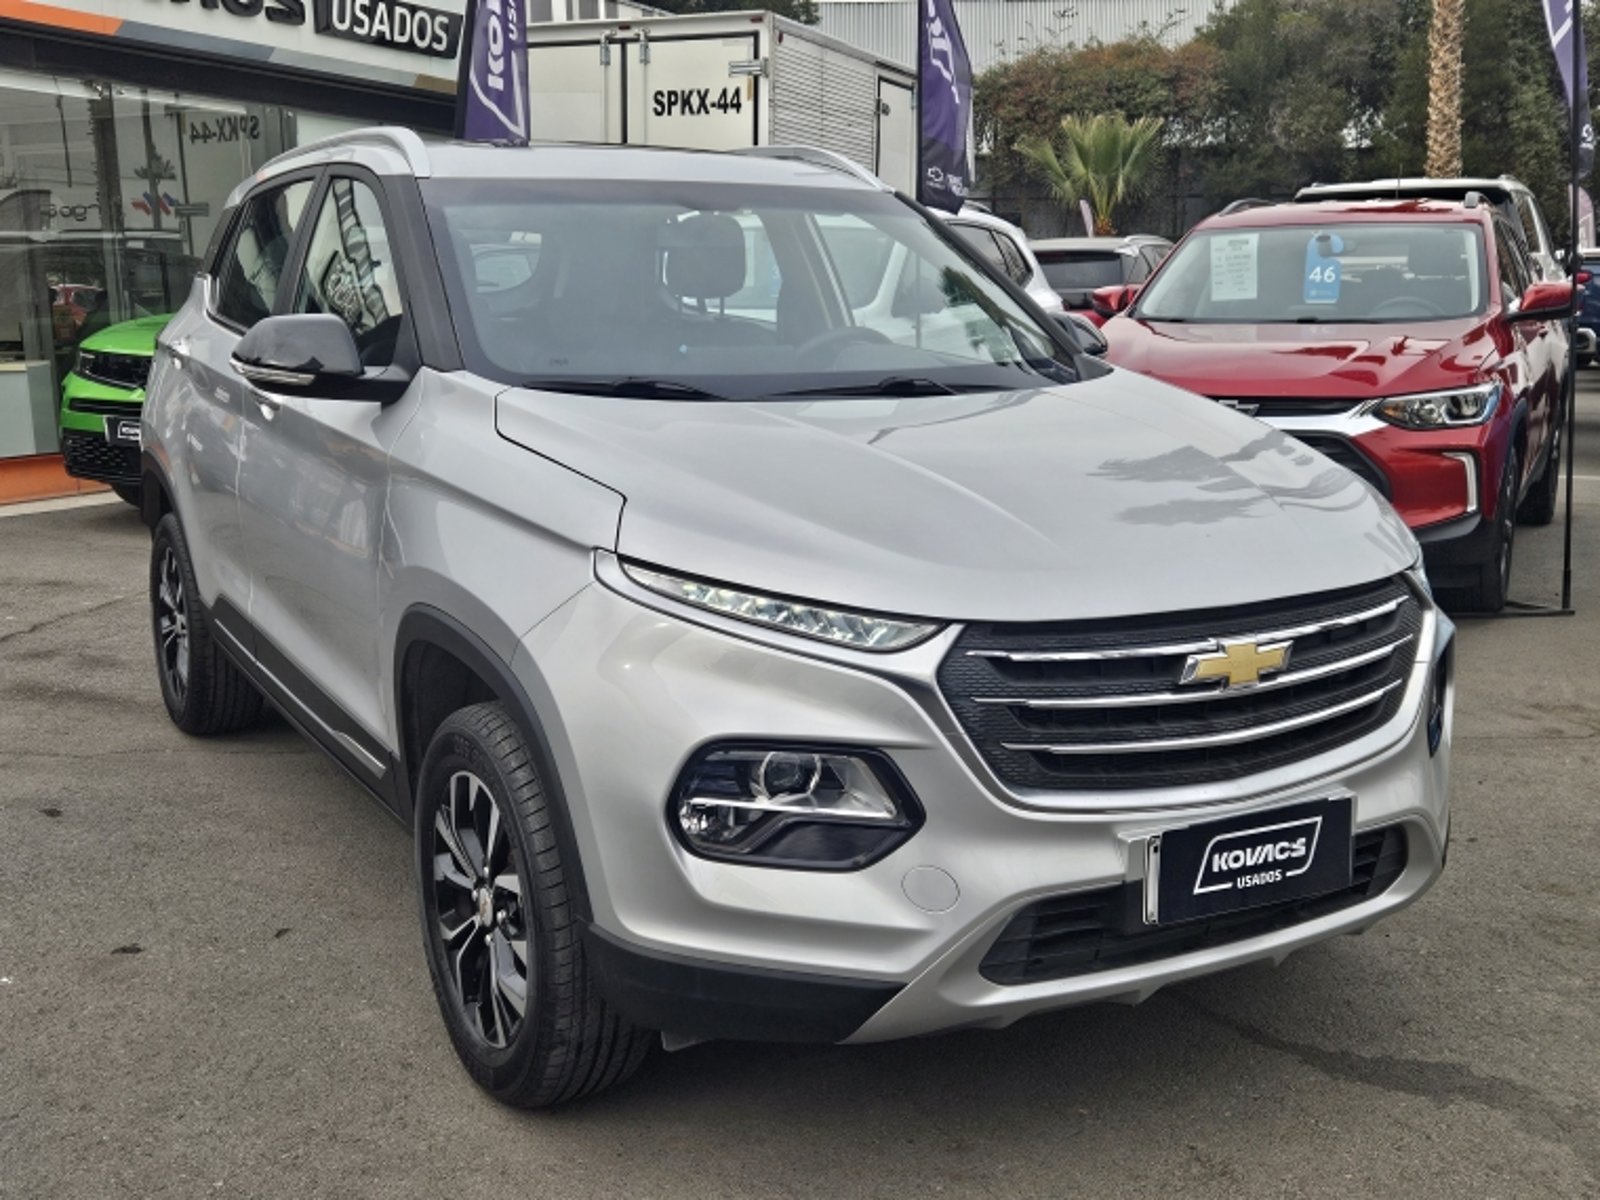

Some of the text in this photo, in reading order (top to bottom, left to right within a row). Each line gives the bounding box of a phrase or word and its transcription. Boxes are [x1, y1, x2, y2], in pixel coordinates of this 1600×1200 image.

[332, 0, 449, 51] USADOS
[653, 86, 742, 116] SPKX-44
[1308, 265, 1336, 283] 46
[1212, 837, 1306, 872] KOVACS
[1237, 869, 1283, 889] USADOS
